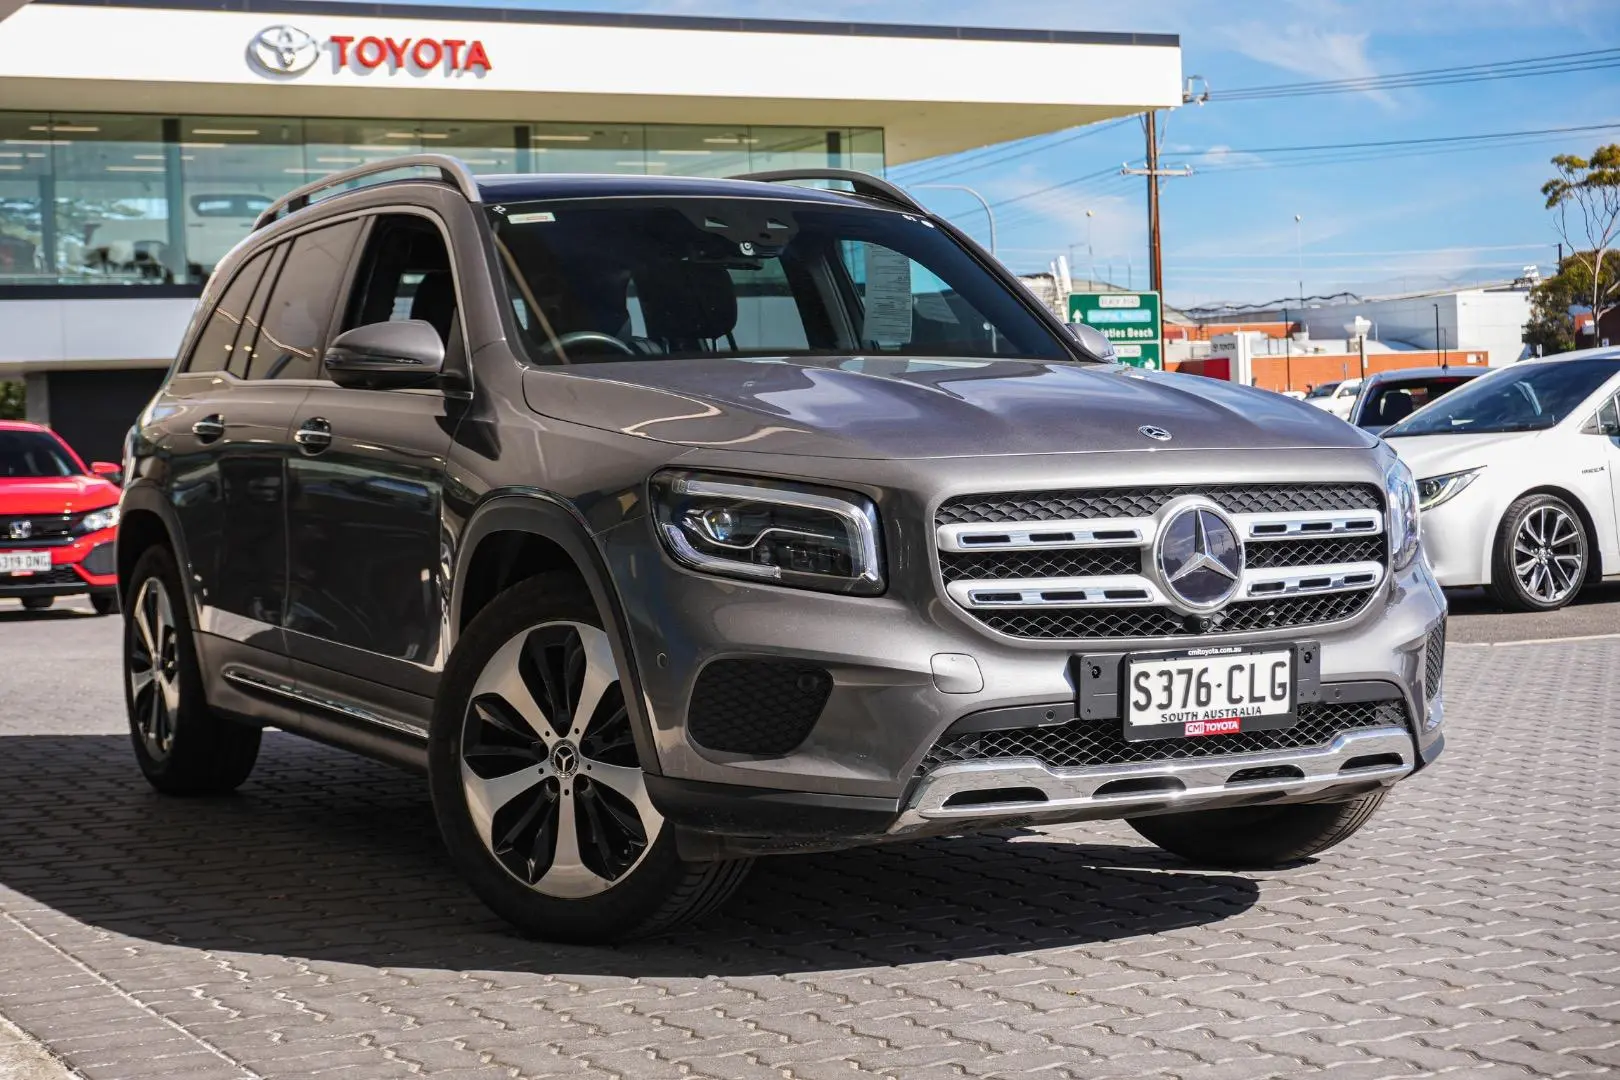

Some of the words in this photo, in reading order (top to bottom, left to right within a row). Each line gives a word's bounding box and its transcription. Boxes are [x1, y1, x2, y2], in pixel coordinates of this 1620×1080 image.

[330, 35, 493, 71] TOYOTA
[1127, 326, 1154, 338] Beach
[1188, 647, 1242, 656] cmitoyota.com.au
[1161, 712, 1199, 723] SOUTH
[1203, 706, 1262, 719] AUSTRALIA
[1187, 723, 1204, 733] CMI
[1204, 720, 1239, 732] TOYOTA
